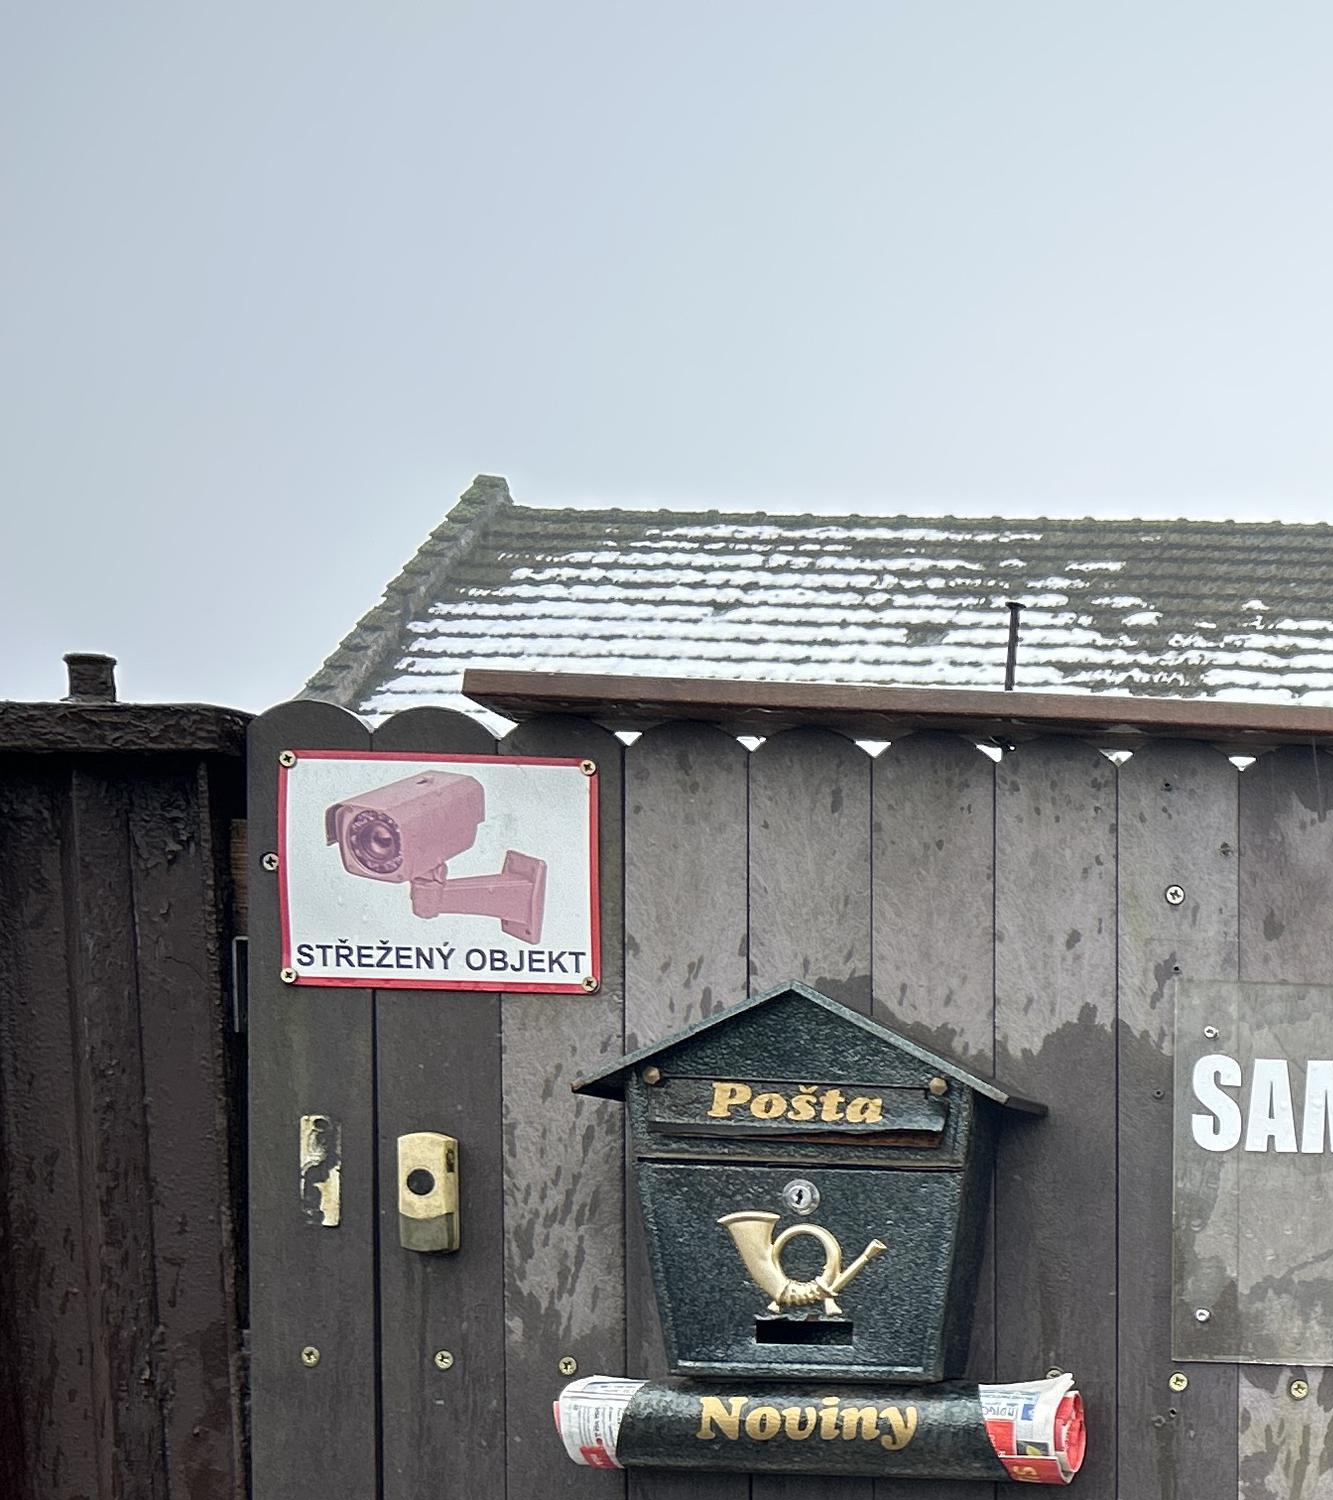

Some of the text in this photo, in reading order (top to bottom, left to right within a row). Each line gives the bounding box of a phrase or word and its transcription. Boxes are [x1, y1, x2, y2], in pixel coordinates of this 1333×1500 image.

[296, 939, 587, 974] STŘEŽENÝ OBJEKT
[707, 1081, 884, 1124] Pošta
[696, 1395, 918, 1451] Noviny
